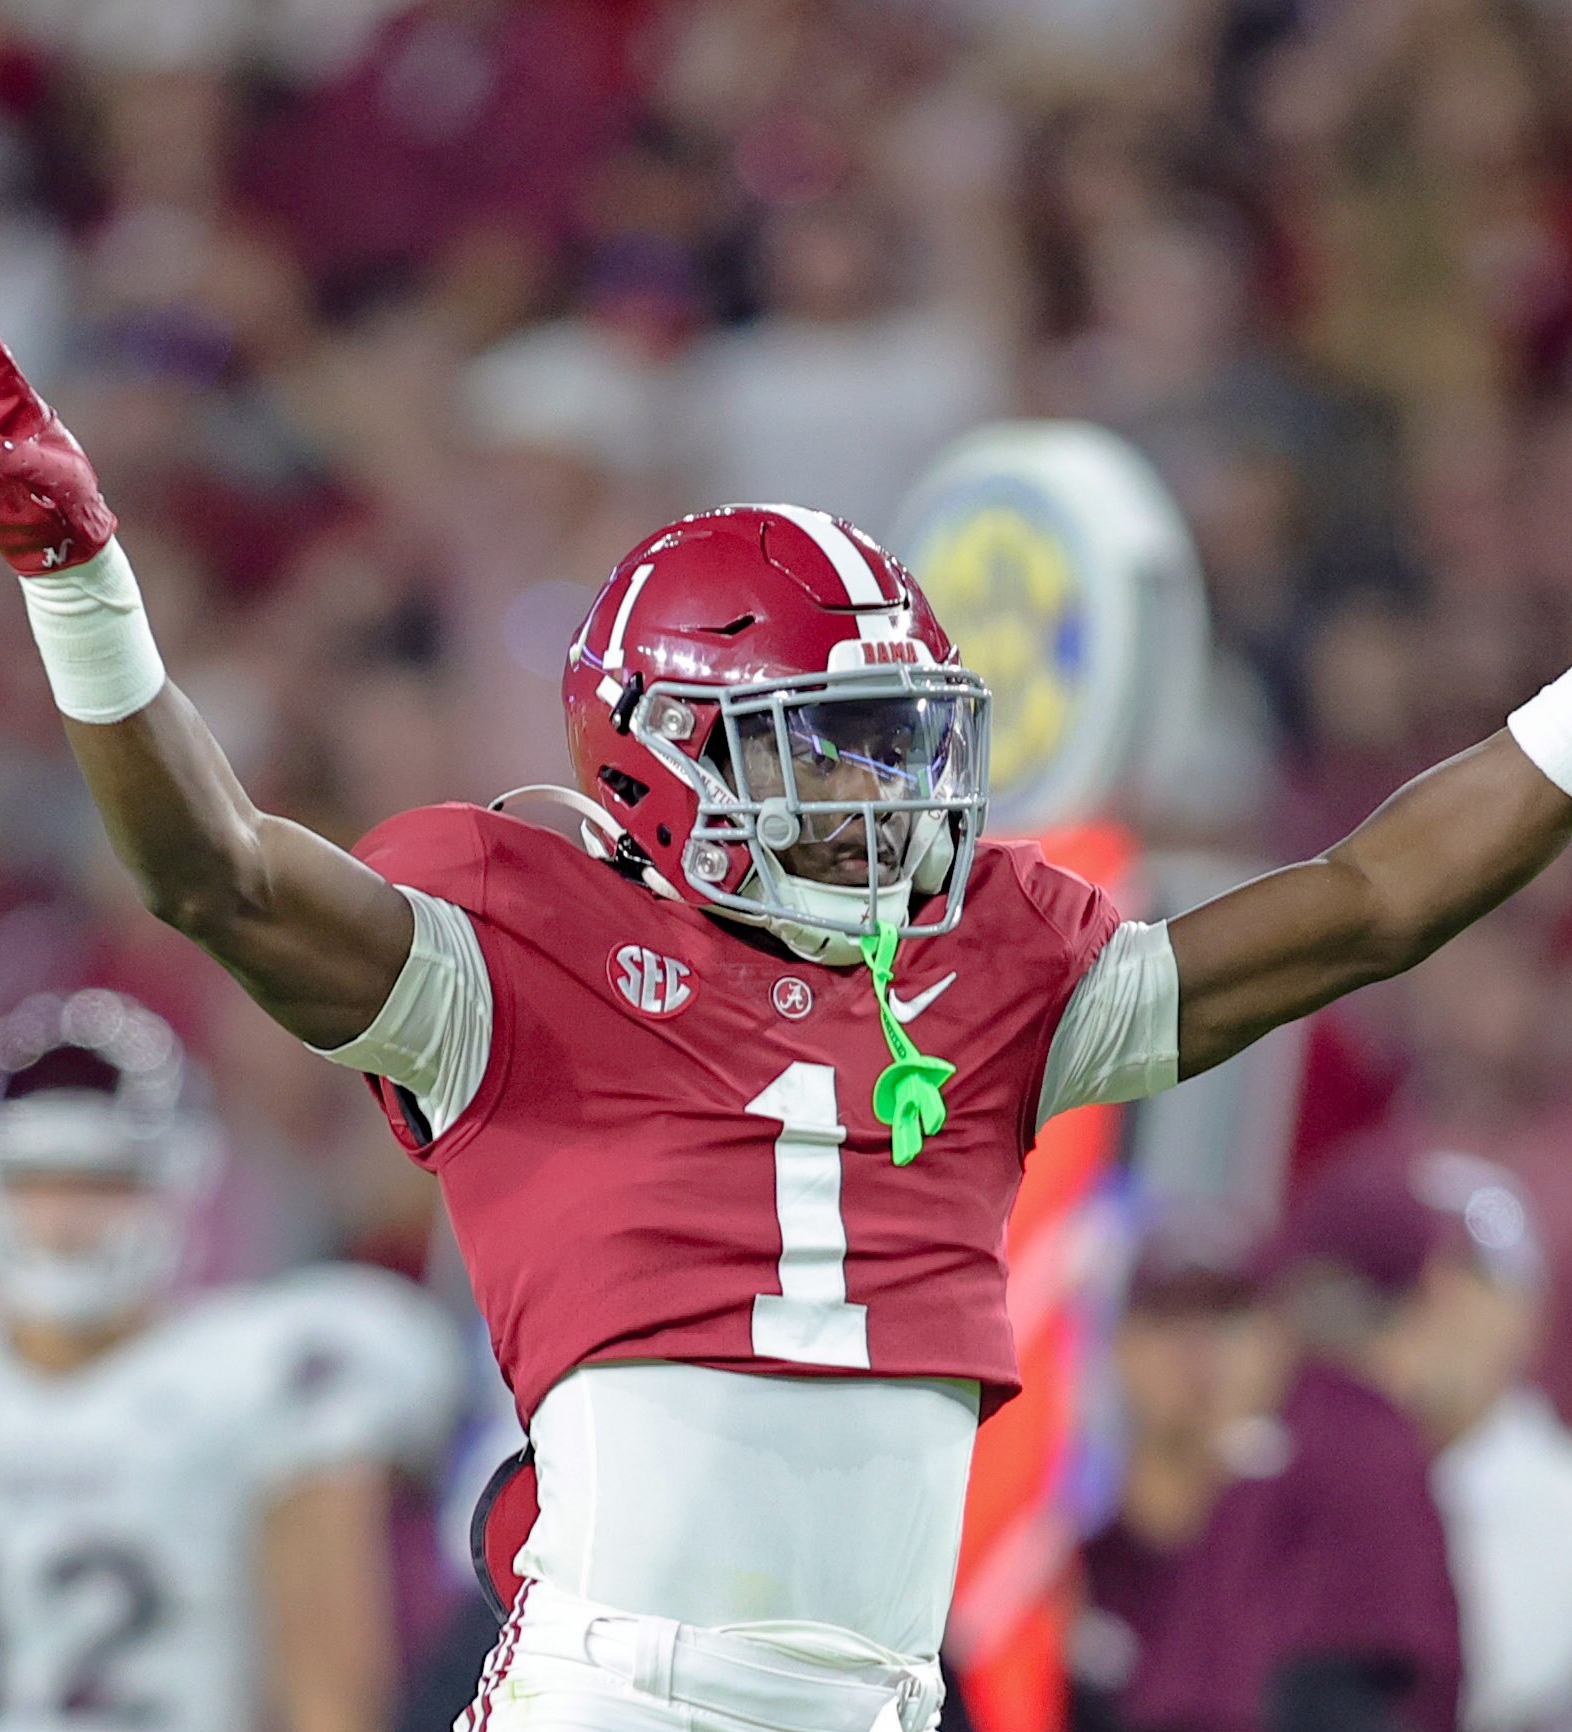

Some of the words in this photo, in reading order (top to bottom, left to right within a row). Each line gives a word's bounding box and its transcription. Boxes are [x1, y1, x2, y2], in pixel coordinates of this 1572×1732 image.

[861, 642, 919, 664] BAMA
[616, 945, 692, 1014] SEC
[744, 1060, 871, 1370] 1
